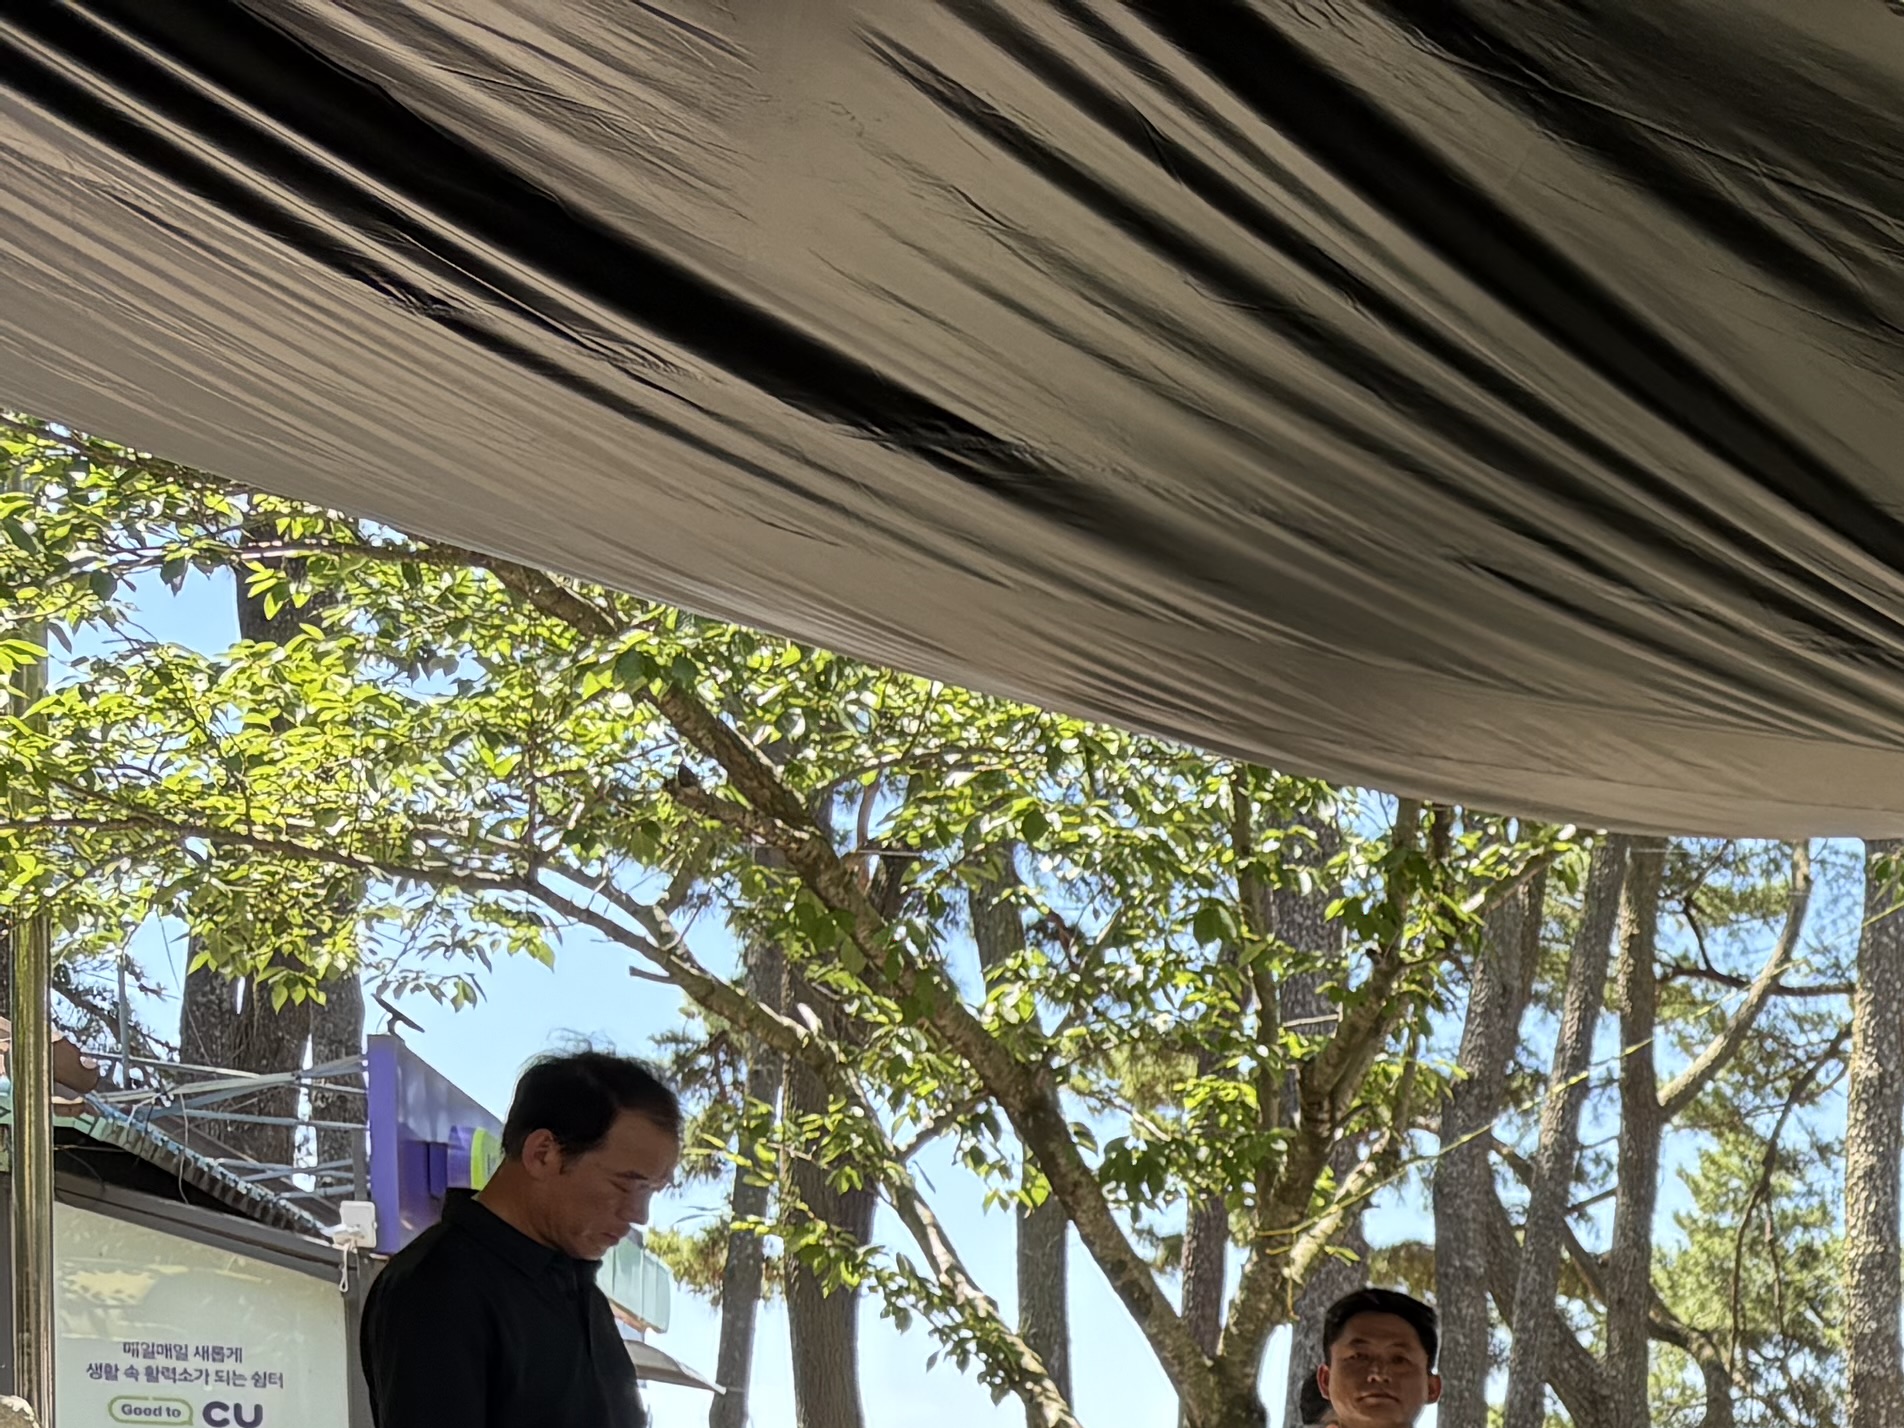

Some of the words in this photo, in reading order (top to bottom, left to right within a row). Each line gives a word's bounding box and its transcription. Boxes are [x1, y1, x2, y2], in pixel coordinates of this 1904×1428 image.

[123, 1340, 189, 1362] 매일매일
[194, 1344, 243, 1364] 새롭게
[124, 1363, 139, 1382] 속
[214, 1369, 247, 1388] 되는
[251, 1370, 284, 1389] 쉼터
[121, 1403, 162, 1418] Good
[166, 1405, 182, 1418] to
